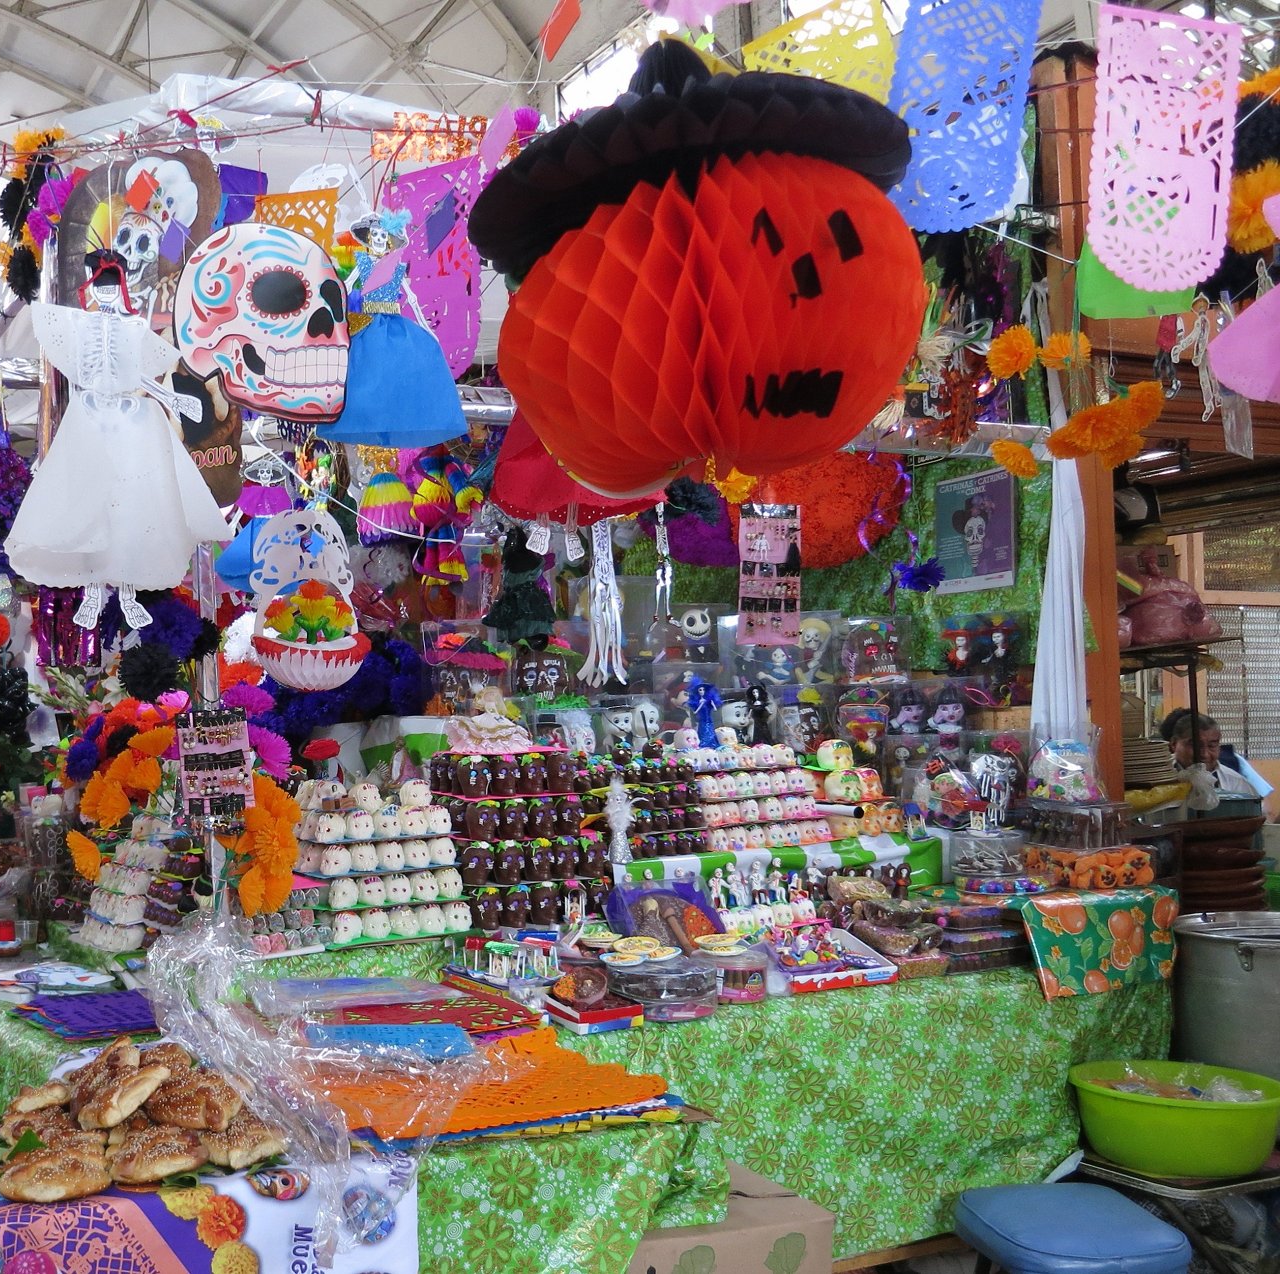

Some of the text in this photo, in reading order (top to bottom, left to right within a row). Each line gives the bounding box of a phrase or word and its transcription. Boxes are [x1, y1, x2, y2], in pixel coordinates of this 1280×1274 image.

[939, 479, 974, 494] CATRINAS
[977, 472, 1009, 486] CATRINES
[965, 485, 986, 496] CDMX
